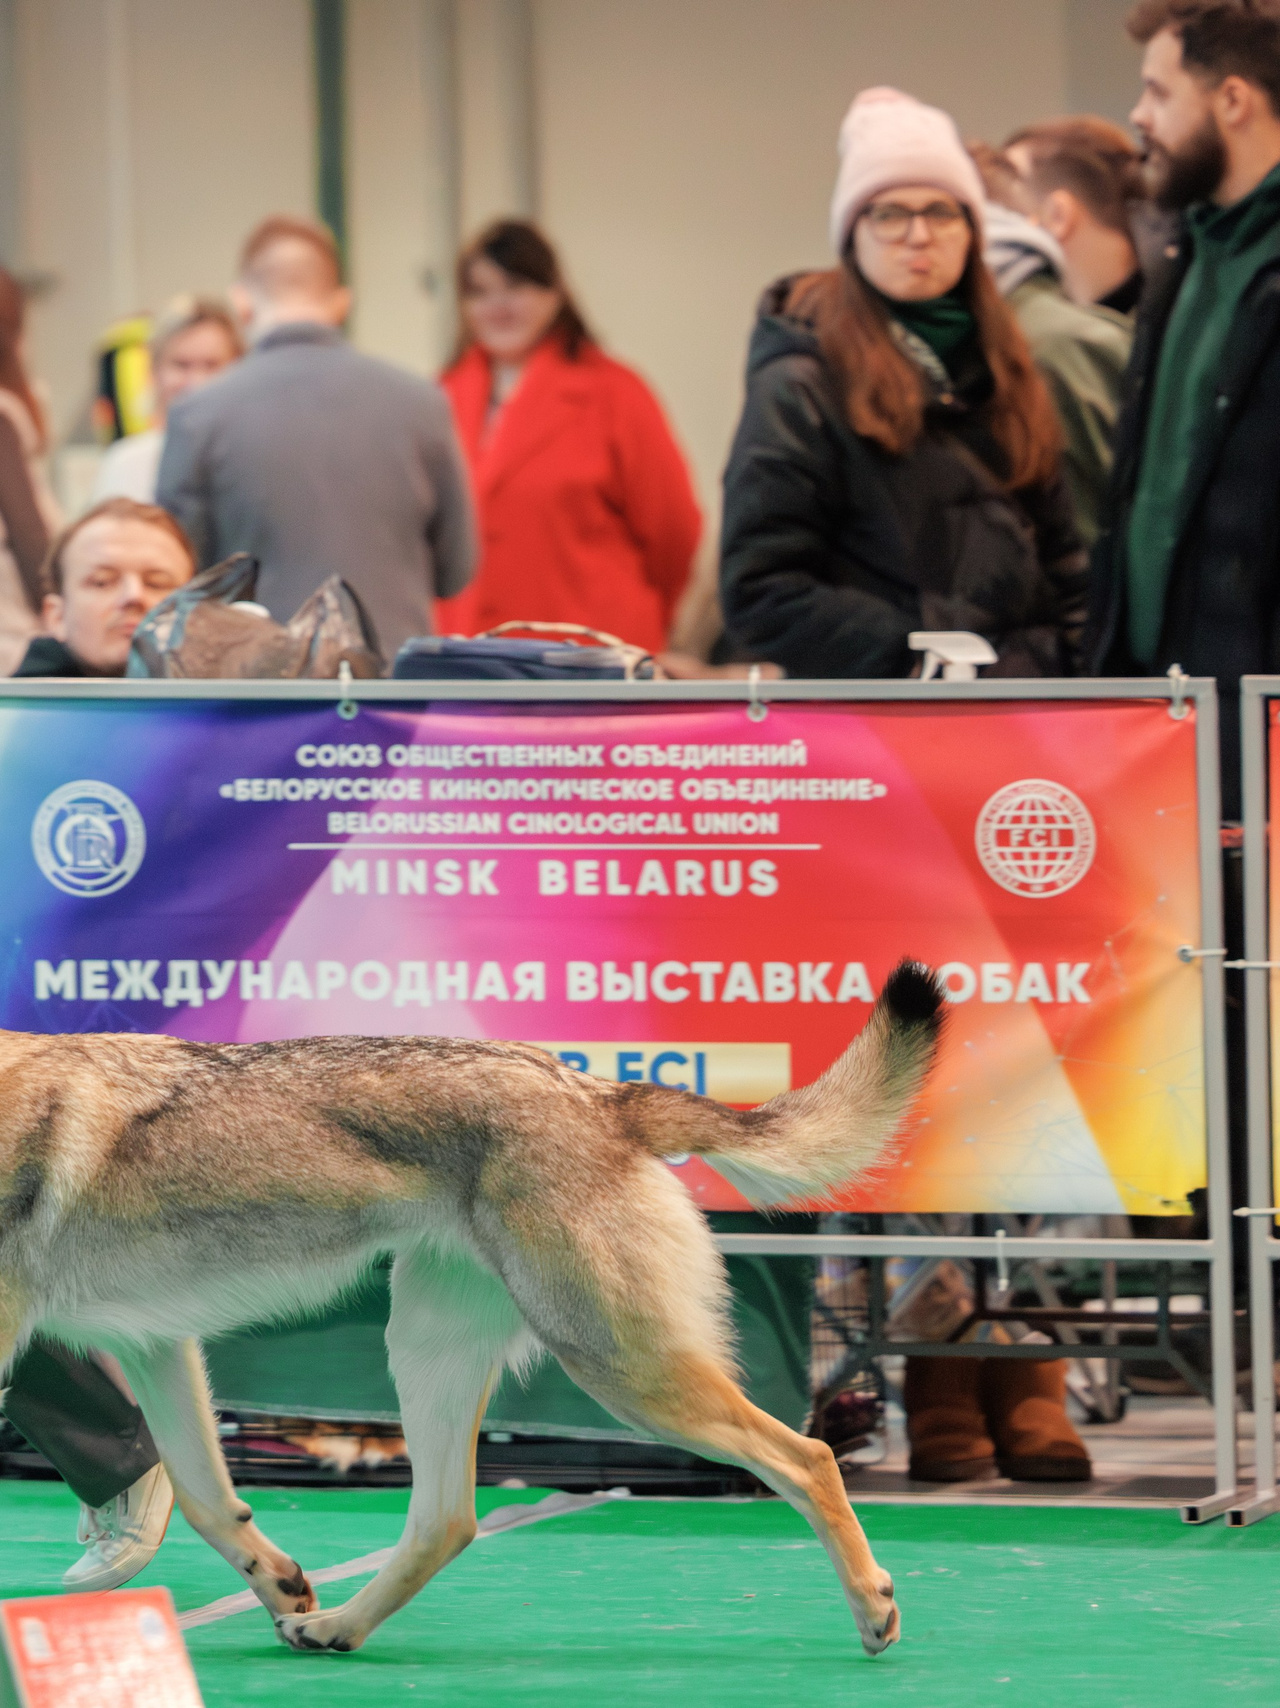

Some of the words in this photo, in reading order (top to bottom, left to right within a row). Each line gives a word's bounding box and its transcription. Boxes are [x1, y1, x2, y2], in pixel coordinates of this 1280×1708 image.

[295, 743, 383, 767] СОЮЗ
[386, 744, 605, 770] ОБЩЕСТВЕННЫХ
[610, 738, 809, 770] ОБЪЕДИНЕНИЙ
[429, 778, 674, 801] КИНОЛОГИЧЕСКОЕ
[327, 811, 501, 835] BELORUSSIAN
[507, 812, 688, 835] CINOLOGICAL
[693, 812, 779, 835] UNION
[1009, 829, 1061, 847] FCI
[331, 859, 499, 896] MINSK
[538, 859, 779, 897] BELARUS
[34, 959, 546, 1006] МЕЖДУНАРОДНАЯ
[566, 961, 875, 1004] ВЫСТАВКА
[910, 961, 1092, 1004] ОБАК
